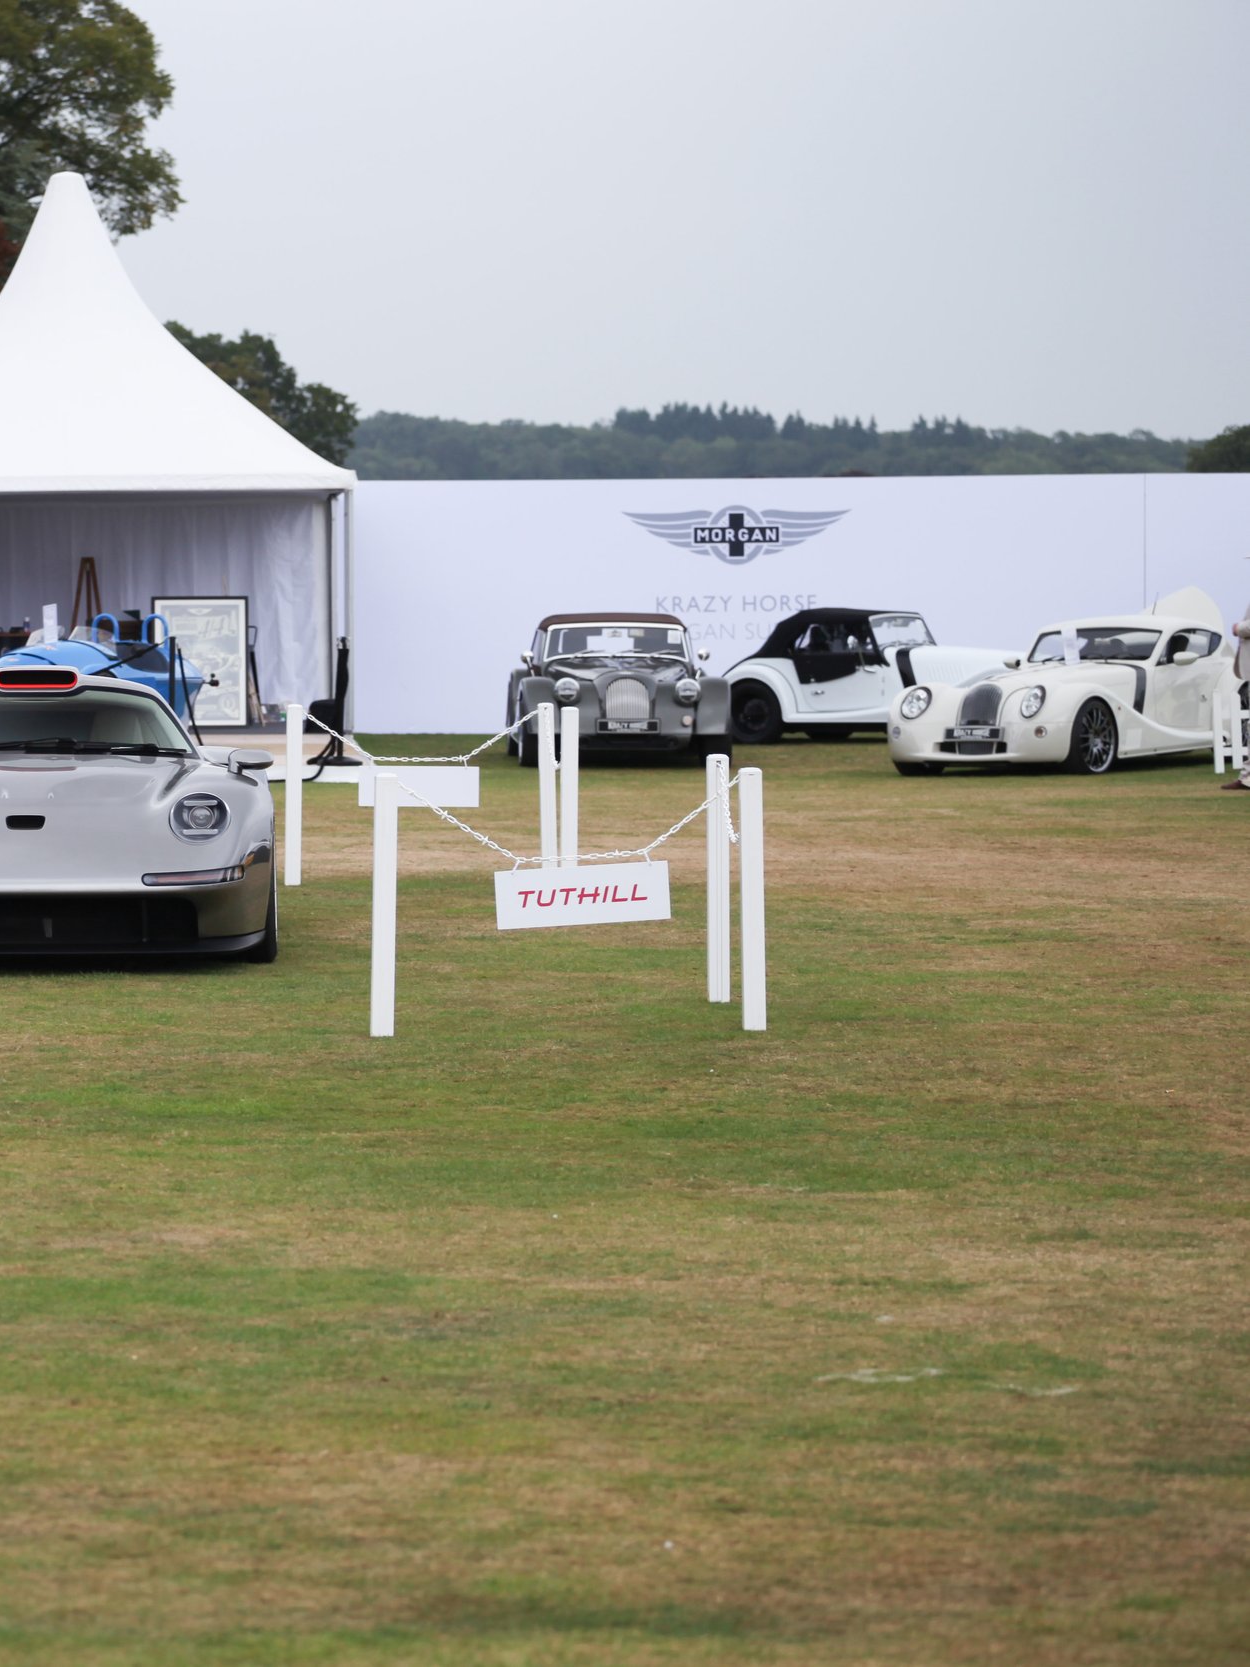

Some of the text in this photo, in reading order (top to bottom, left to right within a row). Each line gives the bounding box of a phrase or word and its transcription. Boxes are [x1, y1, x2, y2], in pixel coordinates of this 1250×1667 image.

[696, 528, 778, 542] MORGAN
[655, 596, 733, 613] KRAZY
[517, 884, 648, 908] TUTHILL
